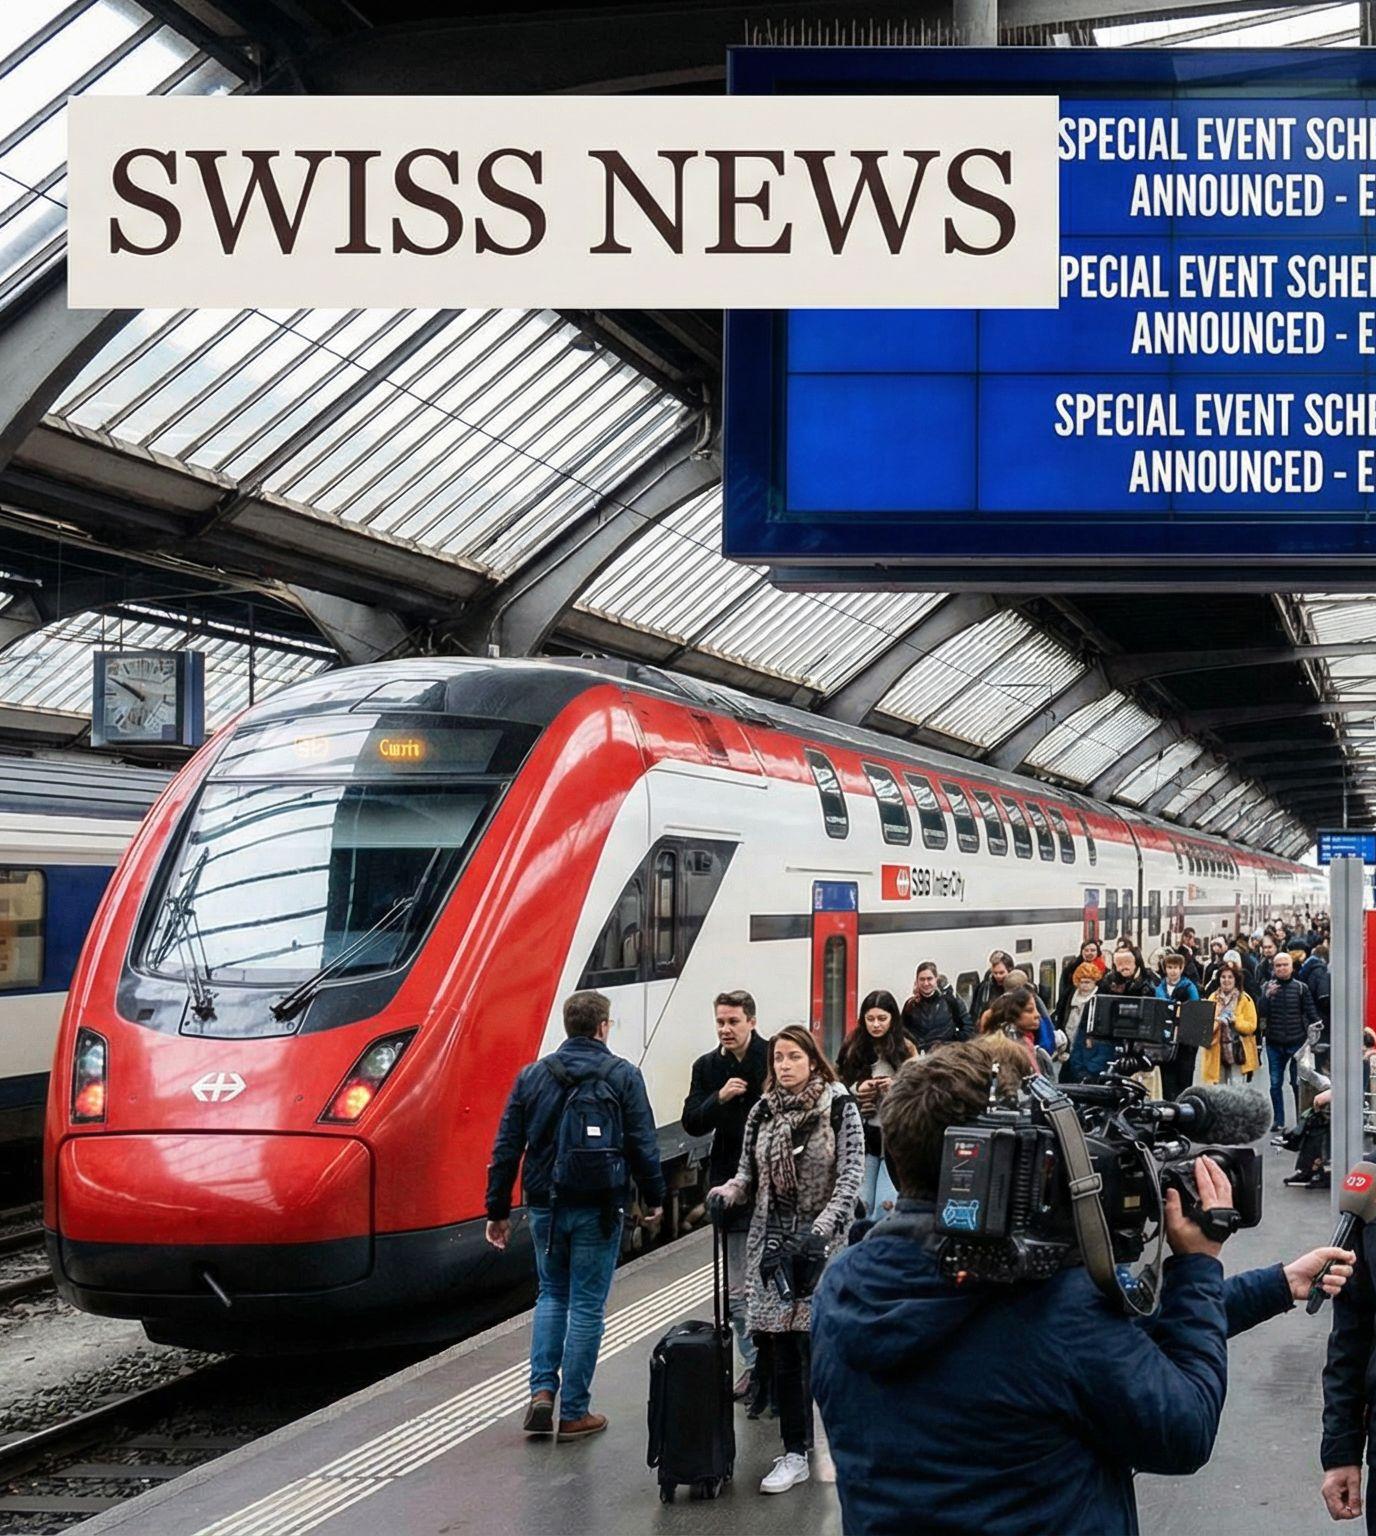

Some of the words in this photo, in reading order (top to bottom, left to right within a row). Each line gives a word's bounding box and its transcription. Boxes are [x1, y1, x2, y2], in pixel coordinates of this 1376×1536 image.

[1058, 117, 1188, 161] SPECIAL
[1197, 117, 1297, 161] EVENT
[1130, 173, 1324, 217] ANNOUNCED
[1179, 254, 1278, 299] EVENT
[1131, 311, 1325, 355] ANNOUNCED
[1054, 393, 1185, 437] SPECIAL
[1195, 393, 1295, 437] EVENT
[1129, 449, 1324, 494] ANNOUNCED
